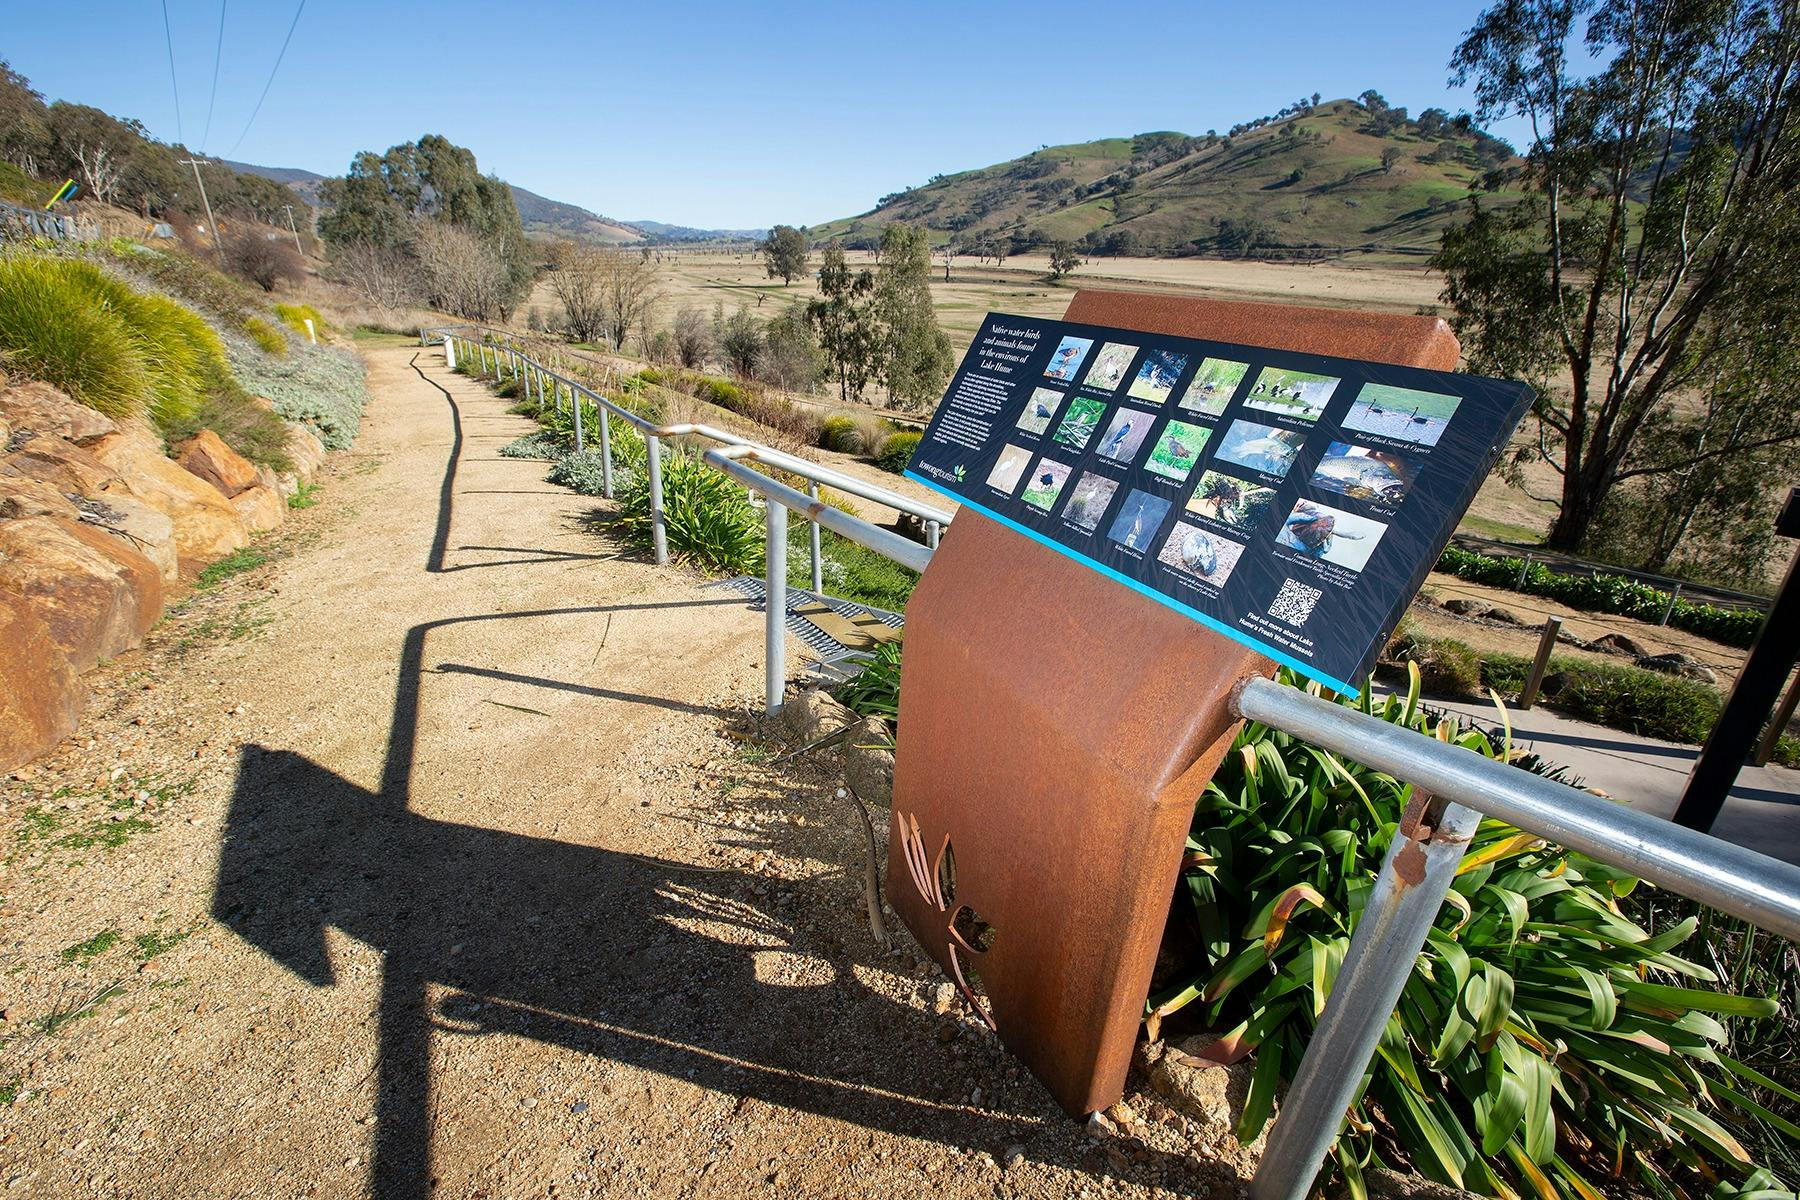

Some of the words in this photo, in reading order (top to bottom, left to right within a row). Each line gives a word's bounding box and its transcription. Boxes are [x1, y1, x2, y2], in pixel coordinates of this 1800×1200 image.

[992, 325, 1008, 334] Native
[1008, 329, 1025, 337] water
[1024, 329, 1040, 339] birds
[994, 338, 1017, 348] animals
[1016, 341, 1036, 351] found
[979, 347, 986, 355] in
[986, 348, 995, 357] the
[995, 351, 1020, 362] environs
[1020, 355, 1029, 363] of
[981, 360, 995, 369] Lake
[994, 362, 1012, 373] Hume
[1247, 612, 1260, 621] Find
[1268, 623, 1283, 632] more
[1283, 630, 1299, 640] about
[1299, 636, 1313, 646] Lake
[1239, 618, 1258, 630] Hume's
[1258, 627, 1273, 638] Fresh
[1274, 634, 1290, 645] Water
[1290, 642, 1313, 657] Mussels
